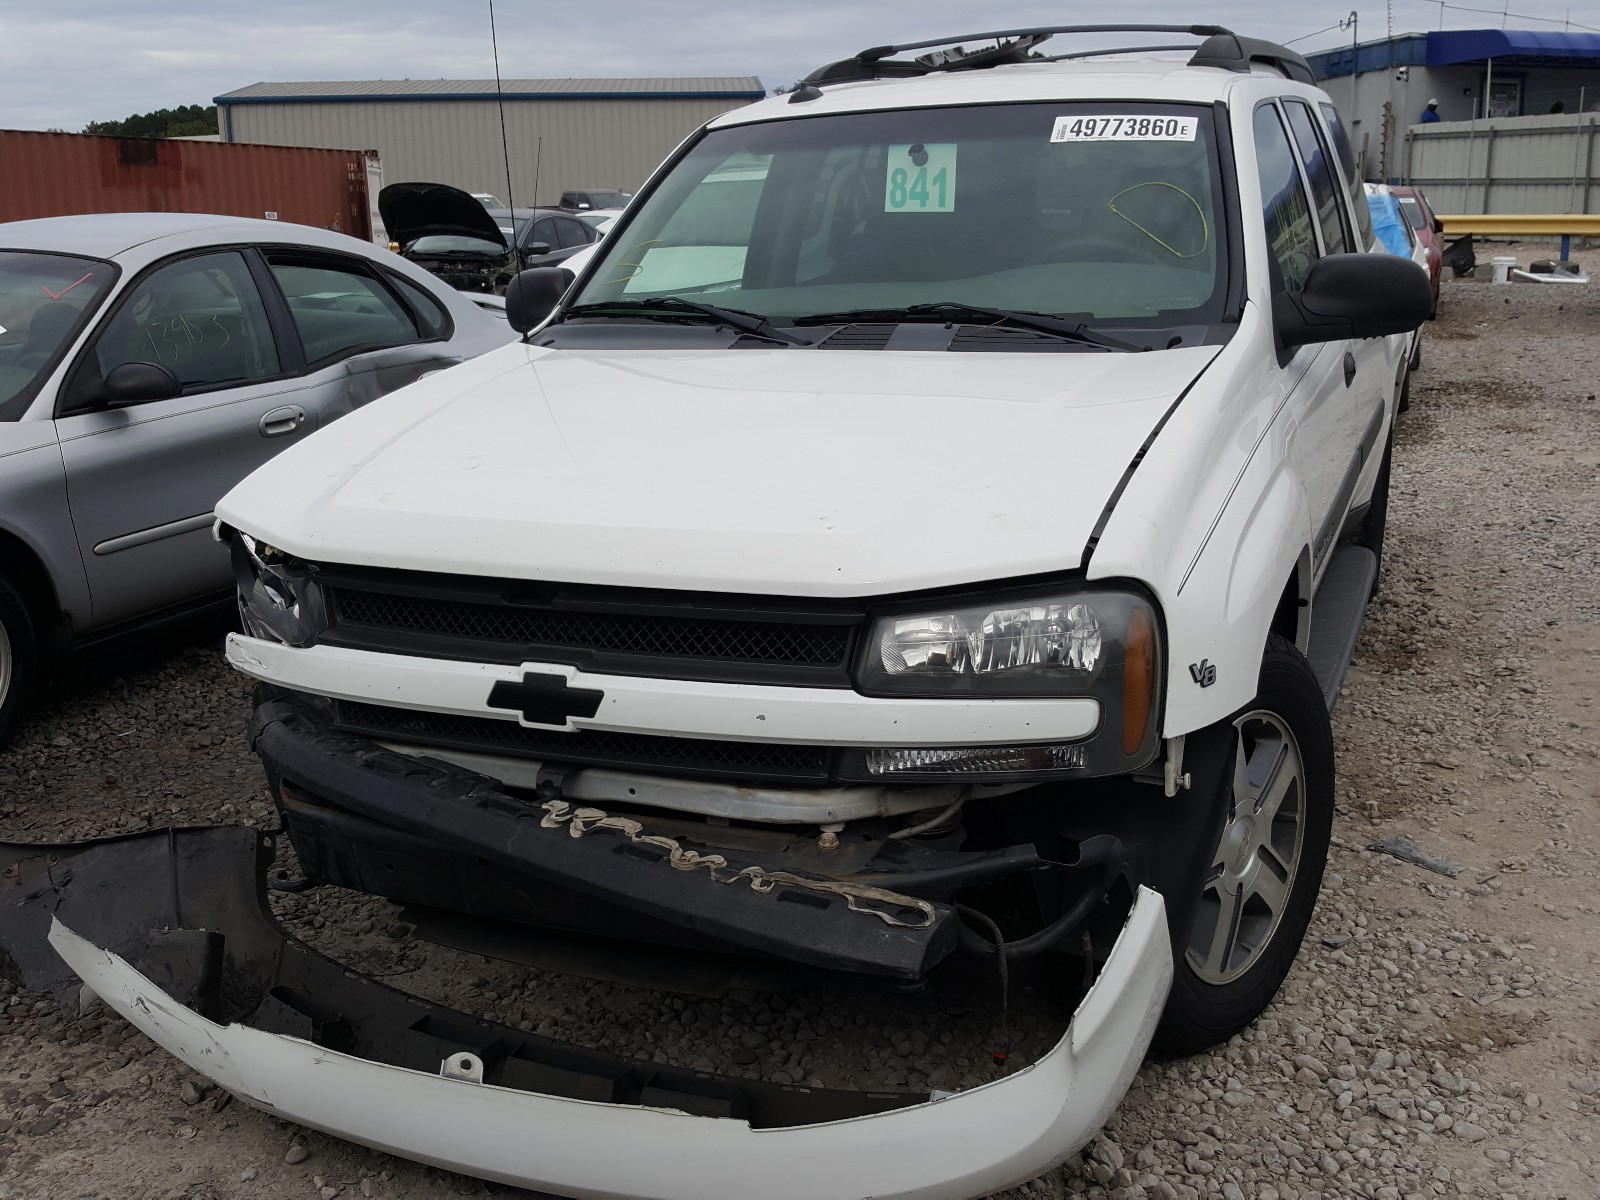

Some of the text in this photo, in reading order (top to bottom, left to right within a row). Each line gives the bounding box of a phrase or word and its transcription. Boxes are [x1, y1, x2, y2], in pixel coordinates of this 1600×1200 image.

[1069, 117, 1179, 138] 49773860
[889, 167, 948, 209] 841
[1188, 657, 1217, 689] V8
